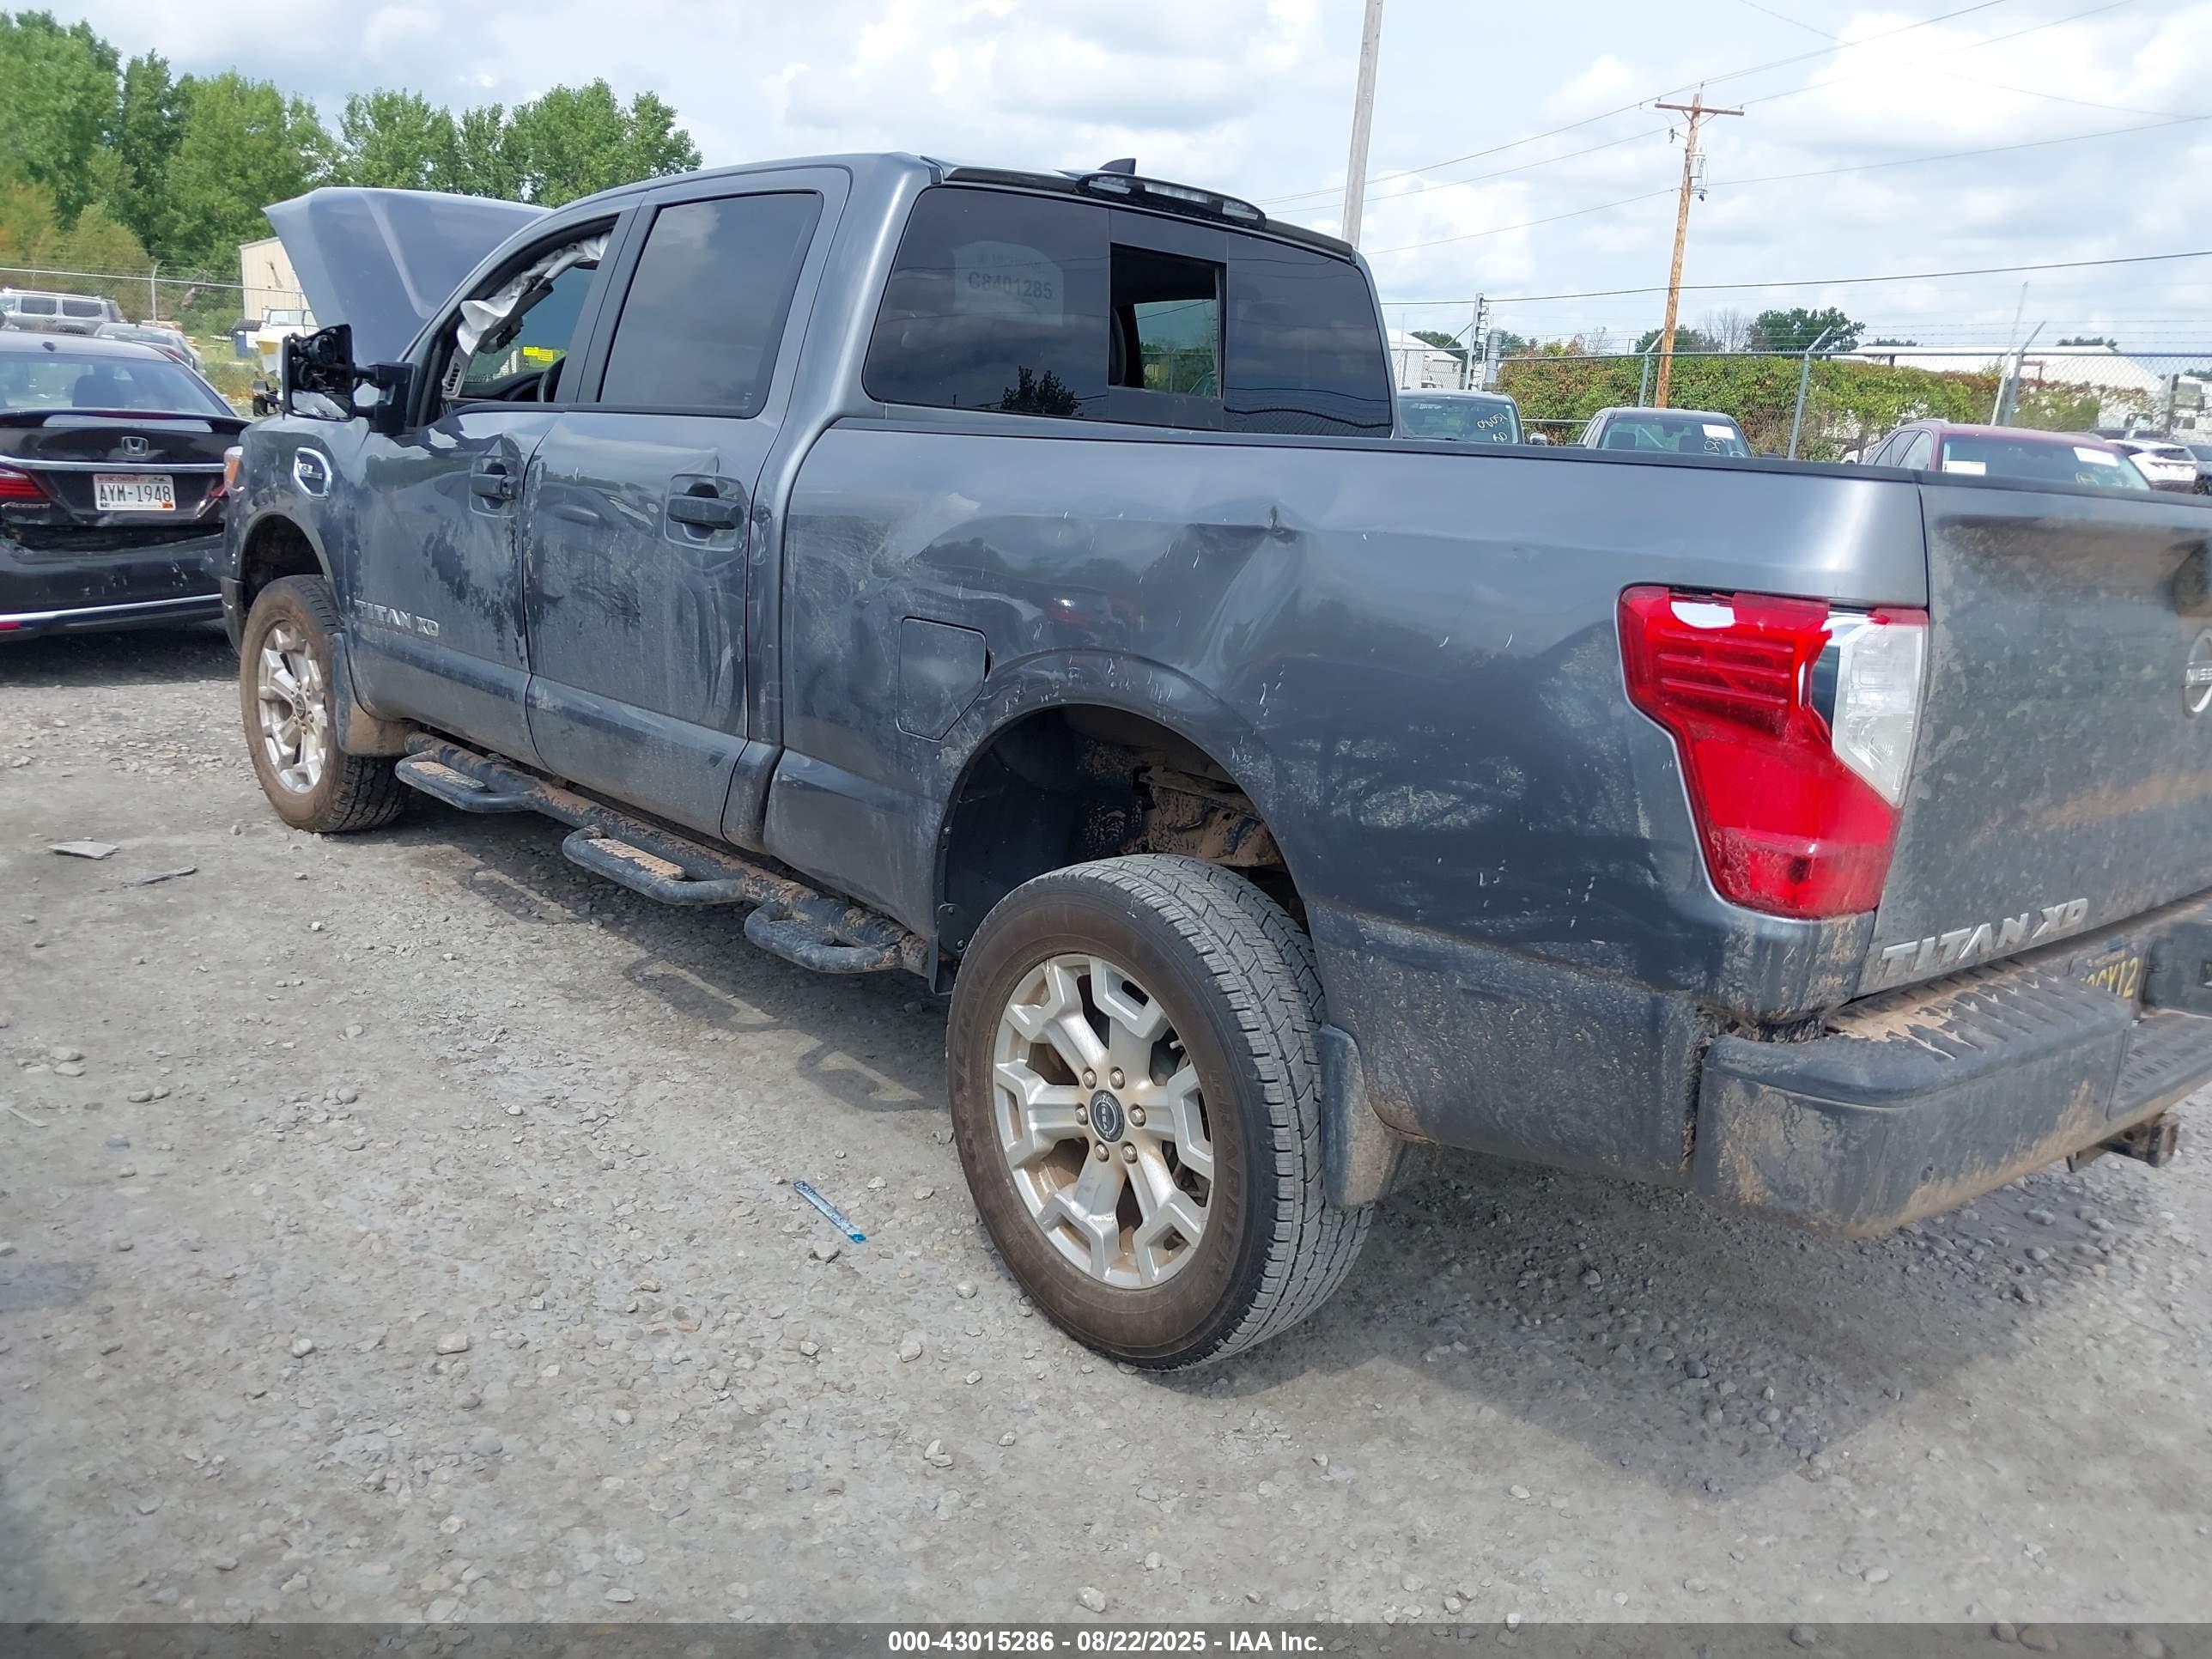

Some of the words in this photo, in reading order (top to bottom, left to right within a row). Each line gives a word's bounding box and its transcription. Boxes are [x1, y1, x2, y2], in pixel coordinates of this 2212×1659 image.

[100, 484, 172, 502] AYM-1948
[354, 599, 412, 629] TITAN
[415, 616, 440, 637] XD
[1879, 913, 2029, 978] TITAN
[2032, 897, 2088, 939] XD
